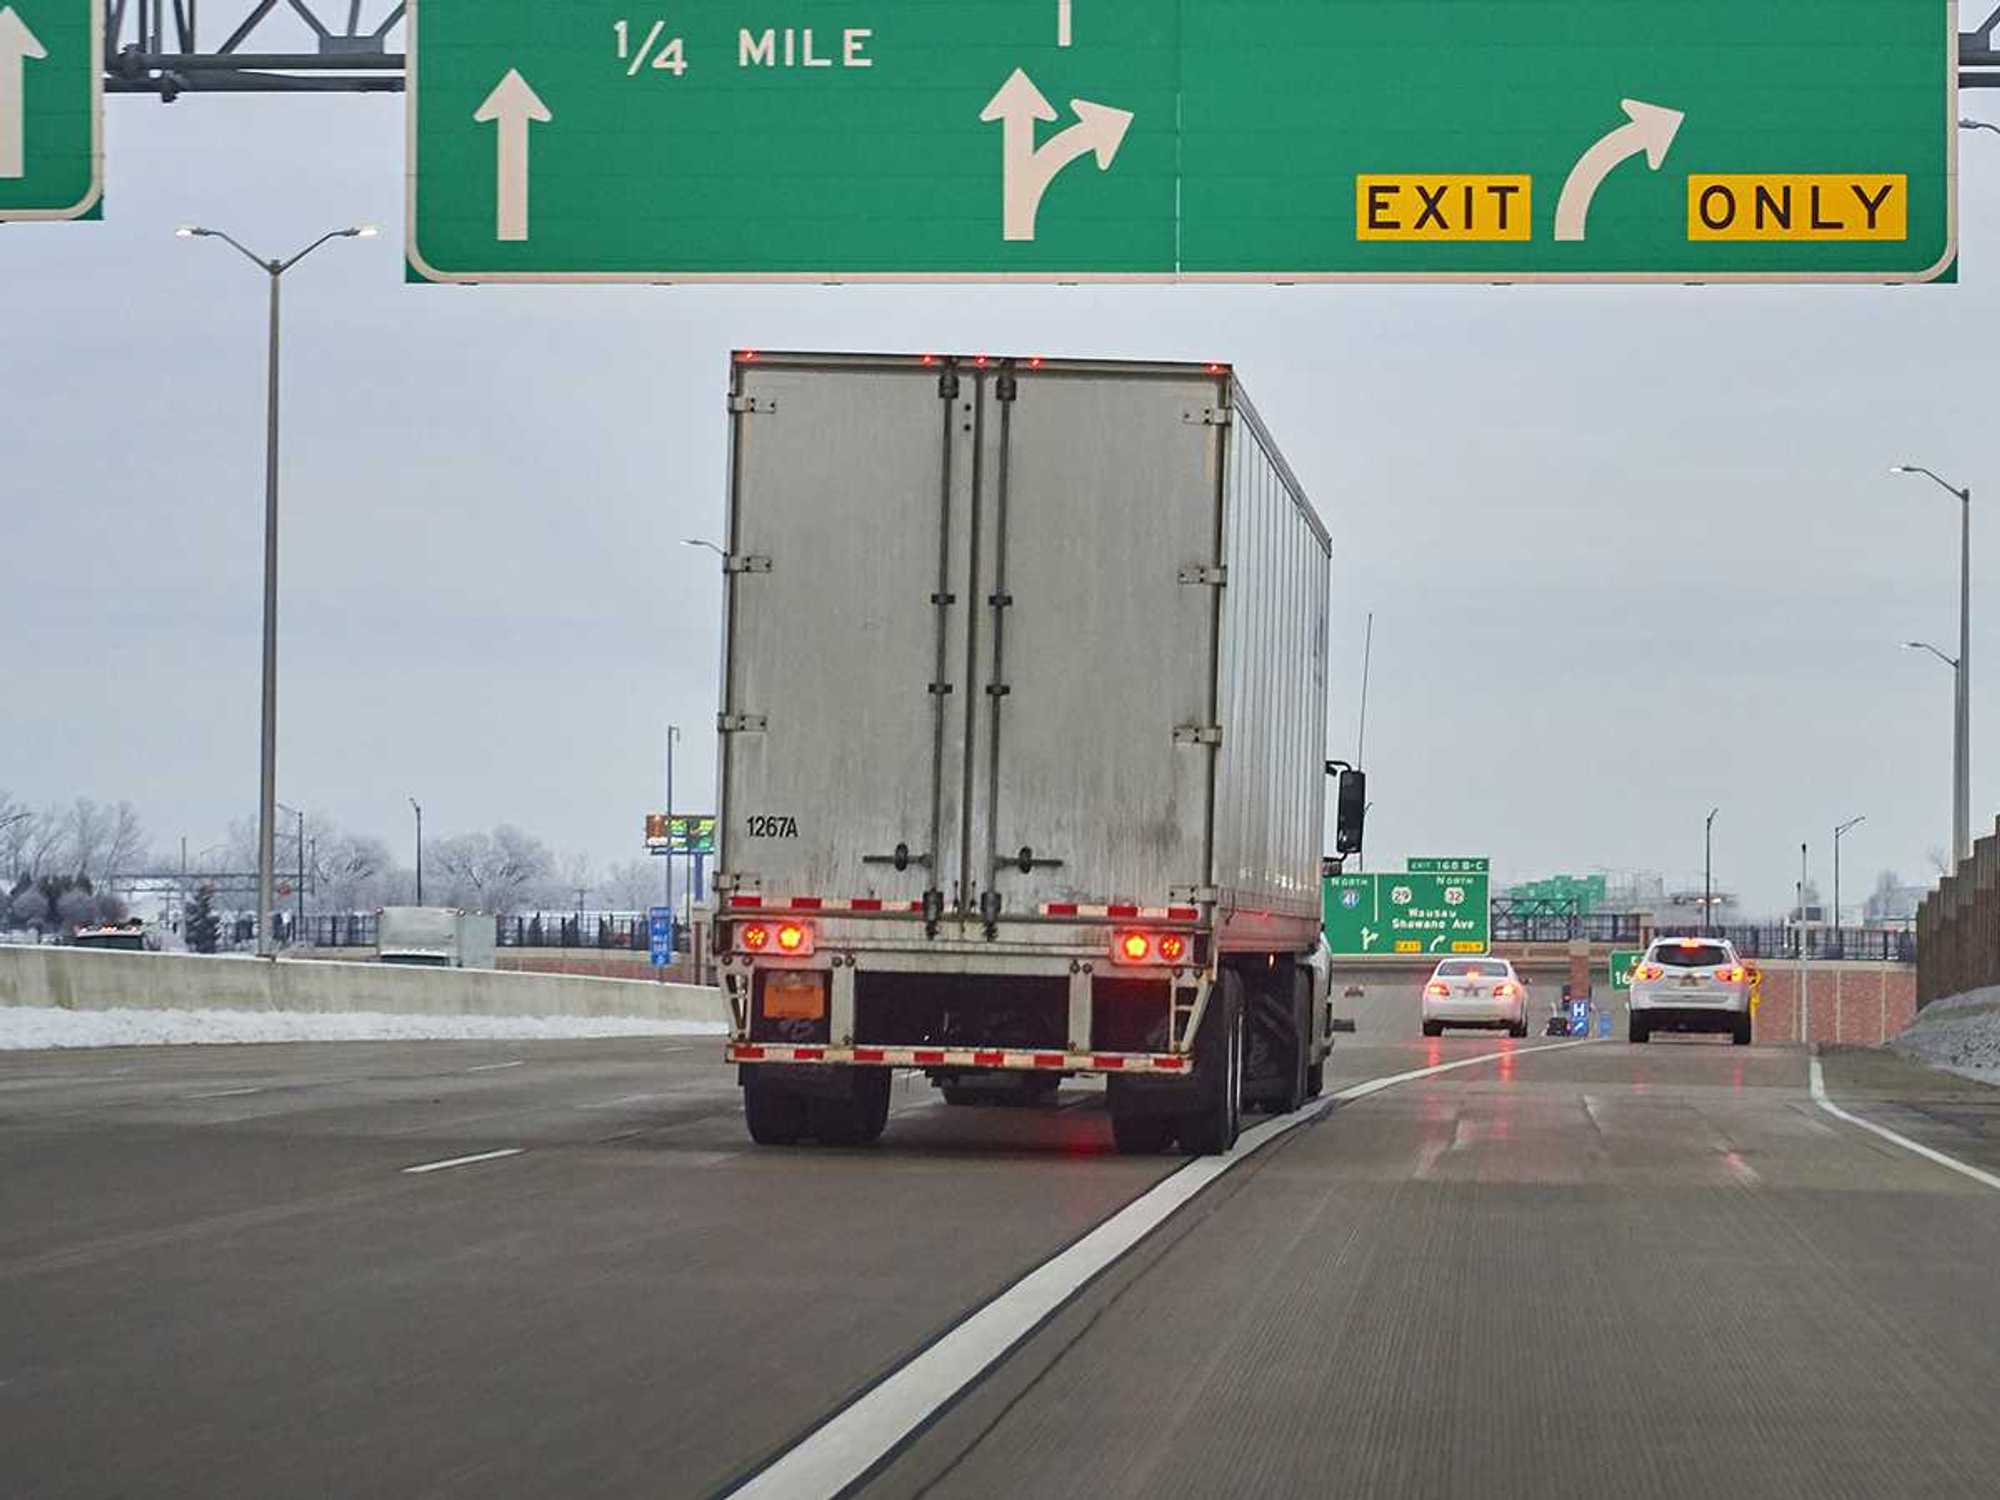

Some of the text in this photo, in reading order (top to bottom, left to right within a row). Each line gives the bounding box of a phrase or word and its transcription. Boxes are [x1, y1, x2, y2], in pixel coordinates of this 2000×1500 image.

[614, 20, 872, 76] 1/4 MILE
[1367, 185, 1519, 230] EXIT
[1699, 185, 1893, 230] ONLY
[747, 816, 798, 837] 1267A
[1391, 918, 1475, 929] Shawano Ave
[1573, 1003, 1585, 1016] H
